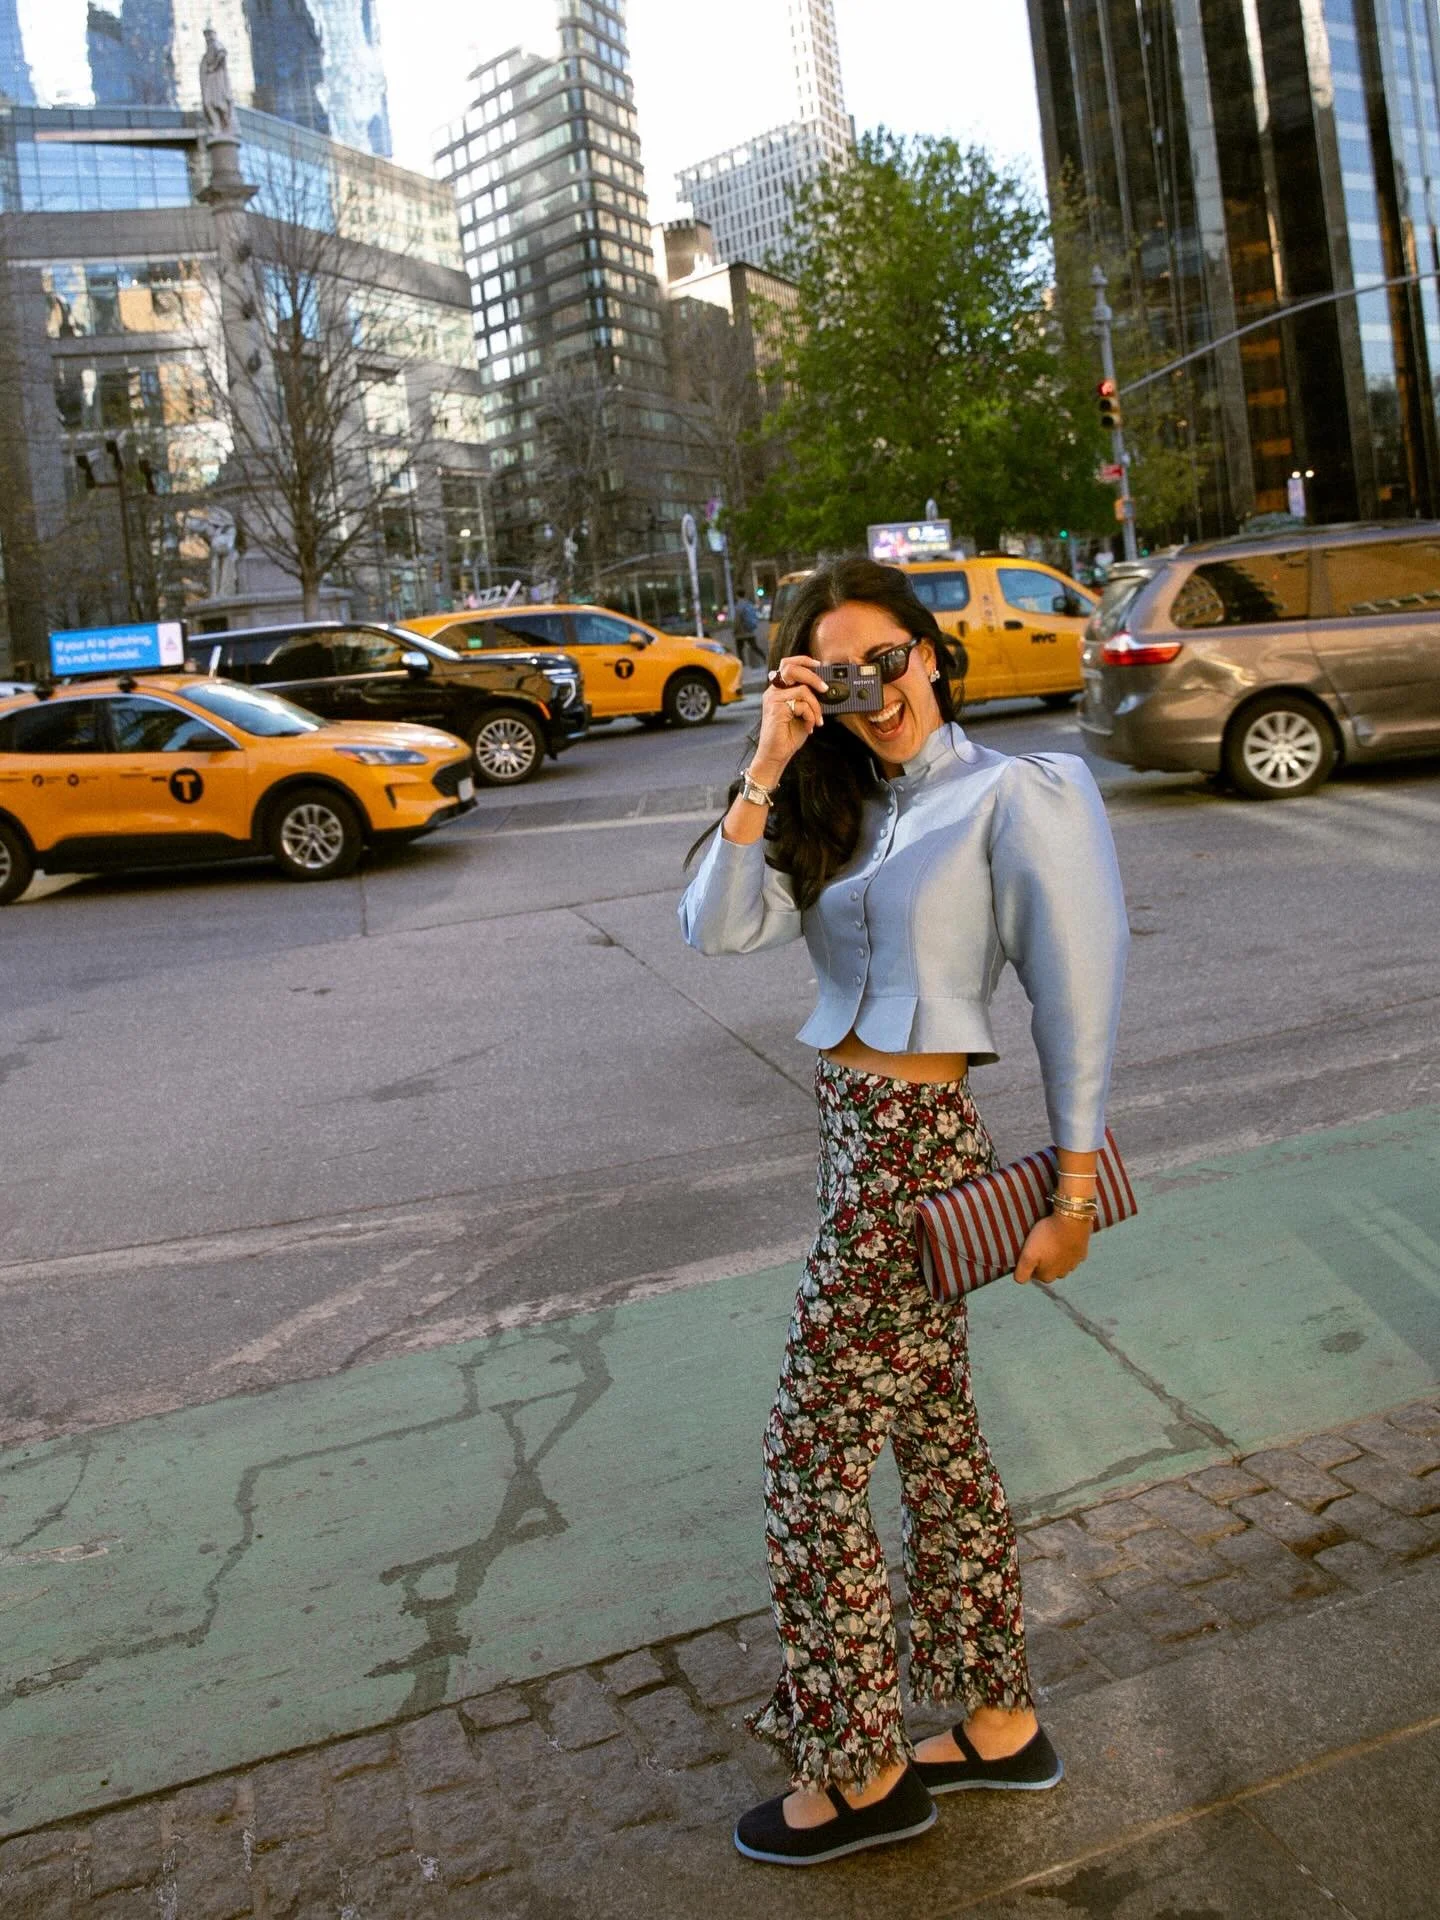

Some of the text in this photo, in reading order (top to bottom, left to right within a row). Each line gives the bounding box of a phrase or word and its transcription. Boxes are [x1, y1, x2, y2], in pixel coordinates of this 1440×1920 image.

[1031, 633, 1057, 644] NYC
[72, 653, 89, 664] not
[90, 652, 106, 662] the
[175, 773, 196, 800] T
